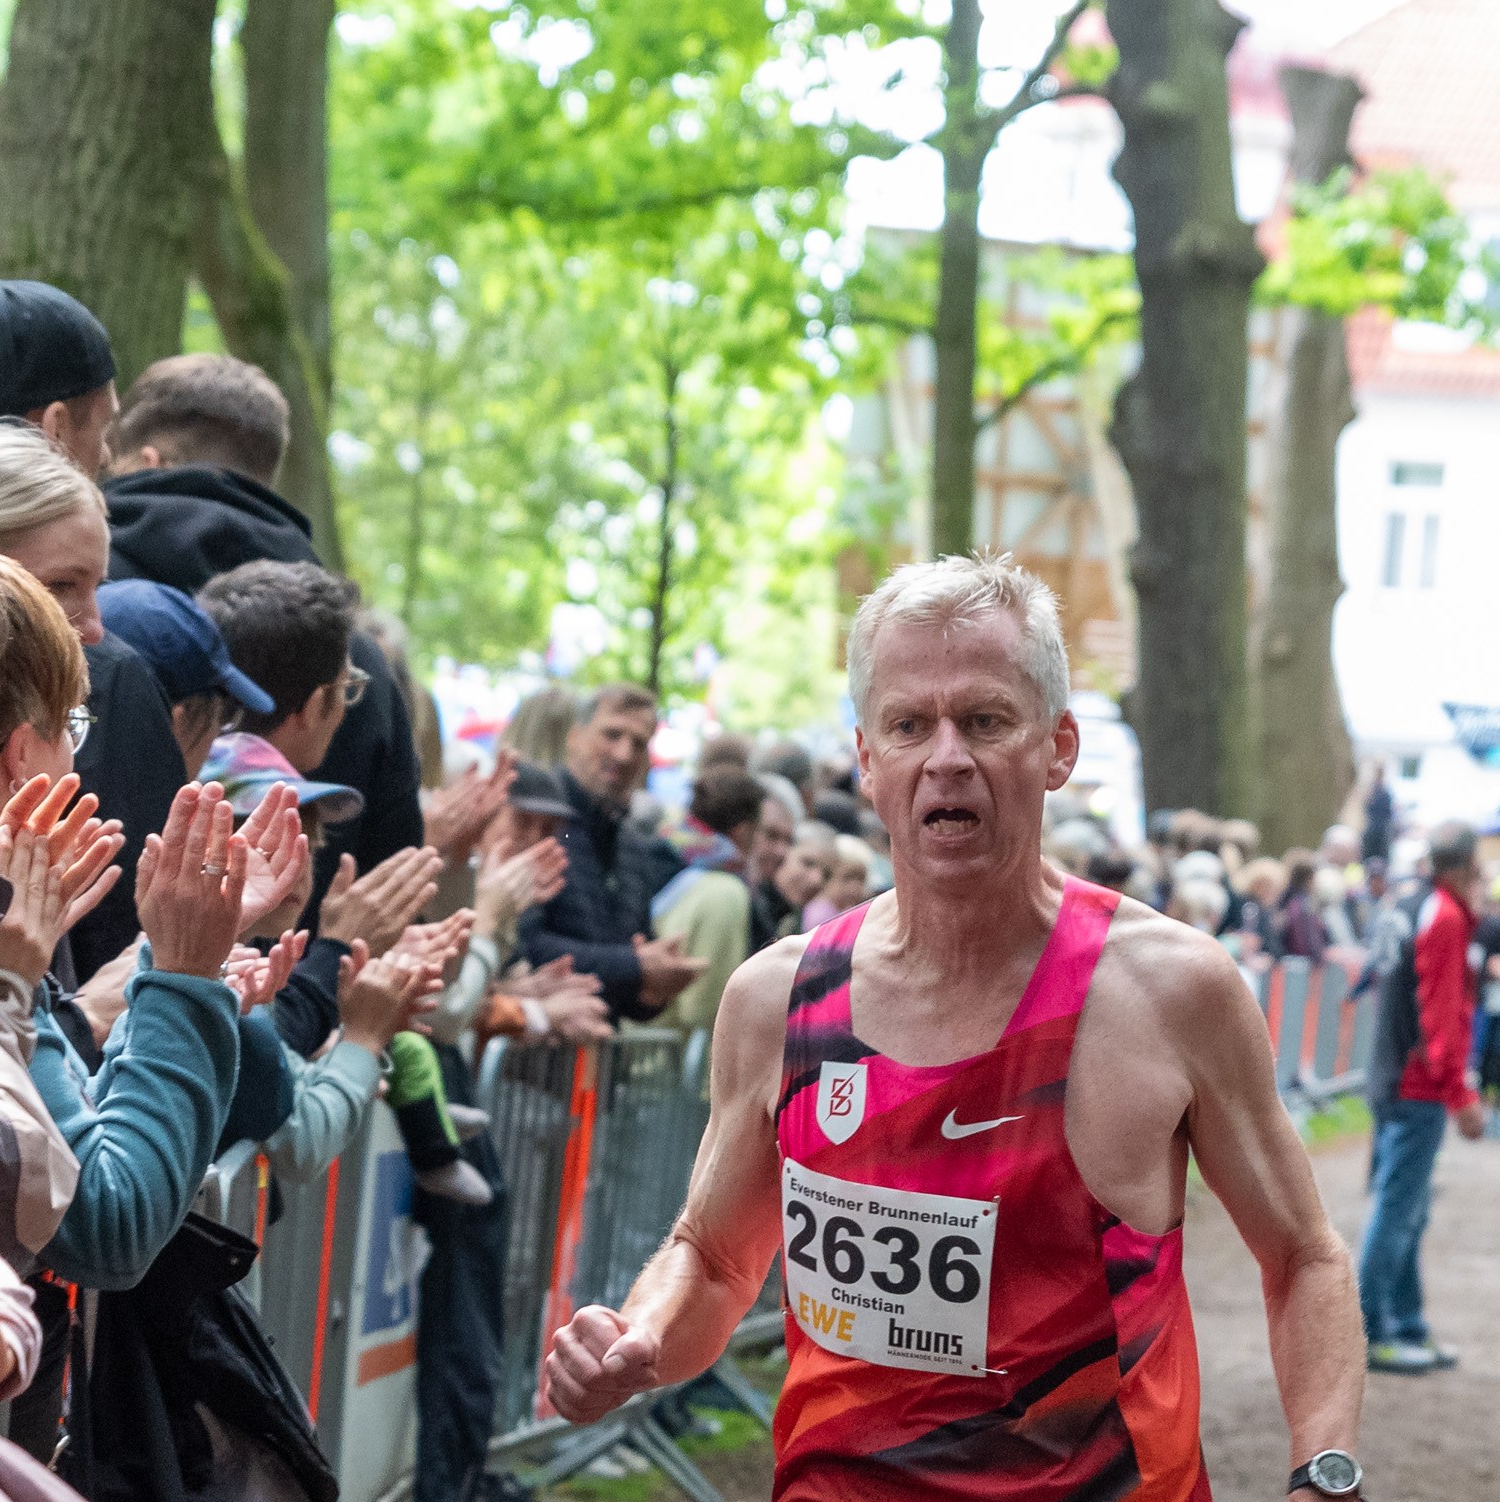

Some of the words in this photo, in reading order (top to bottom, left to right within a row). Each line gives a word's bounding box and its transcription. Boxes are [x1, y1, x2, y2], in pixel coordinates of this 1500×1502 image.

[790, 1177, 863, 1213] Everstener
[868, 1201, 979, 1229] Brunnenlauf
[786, 1199, 982, 1304] 2636
[799, 1292, 856, 1342] EWE
[831, 1287, 905, 1315] Christian
[888, 1317, 963, 1356] bruns
